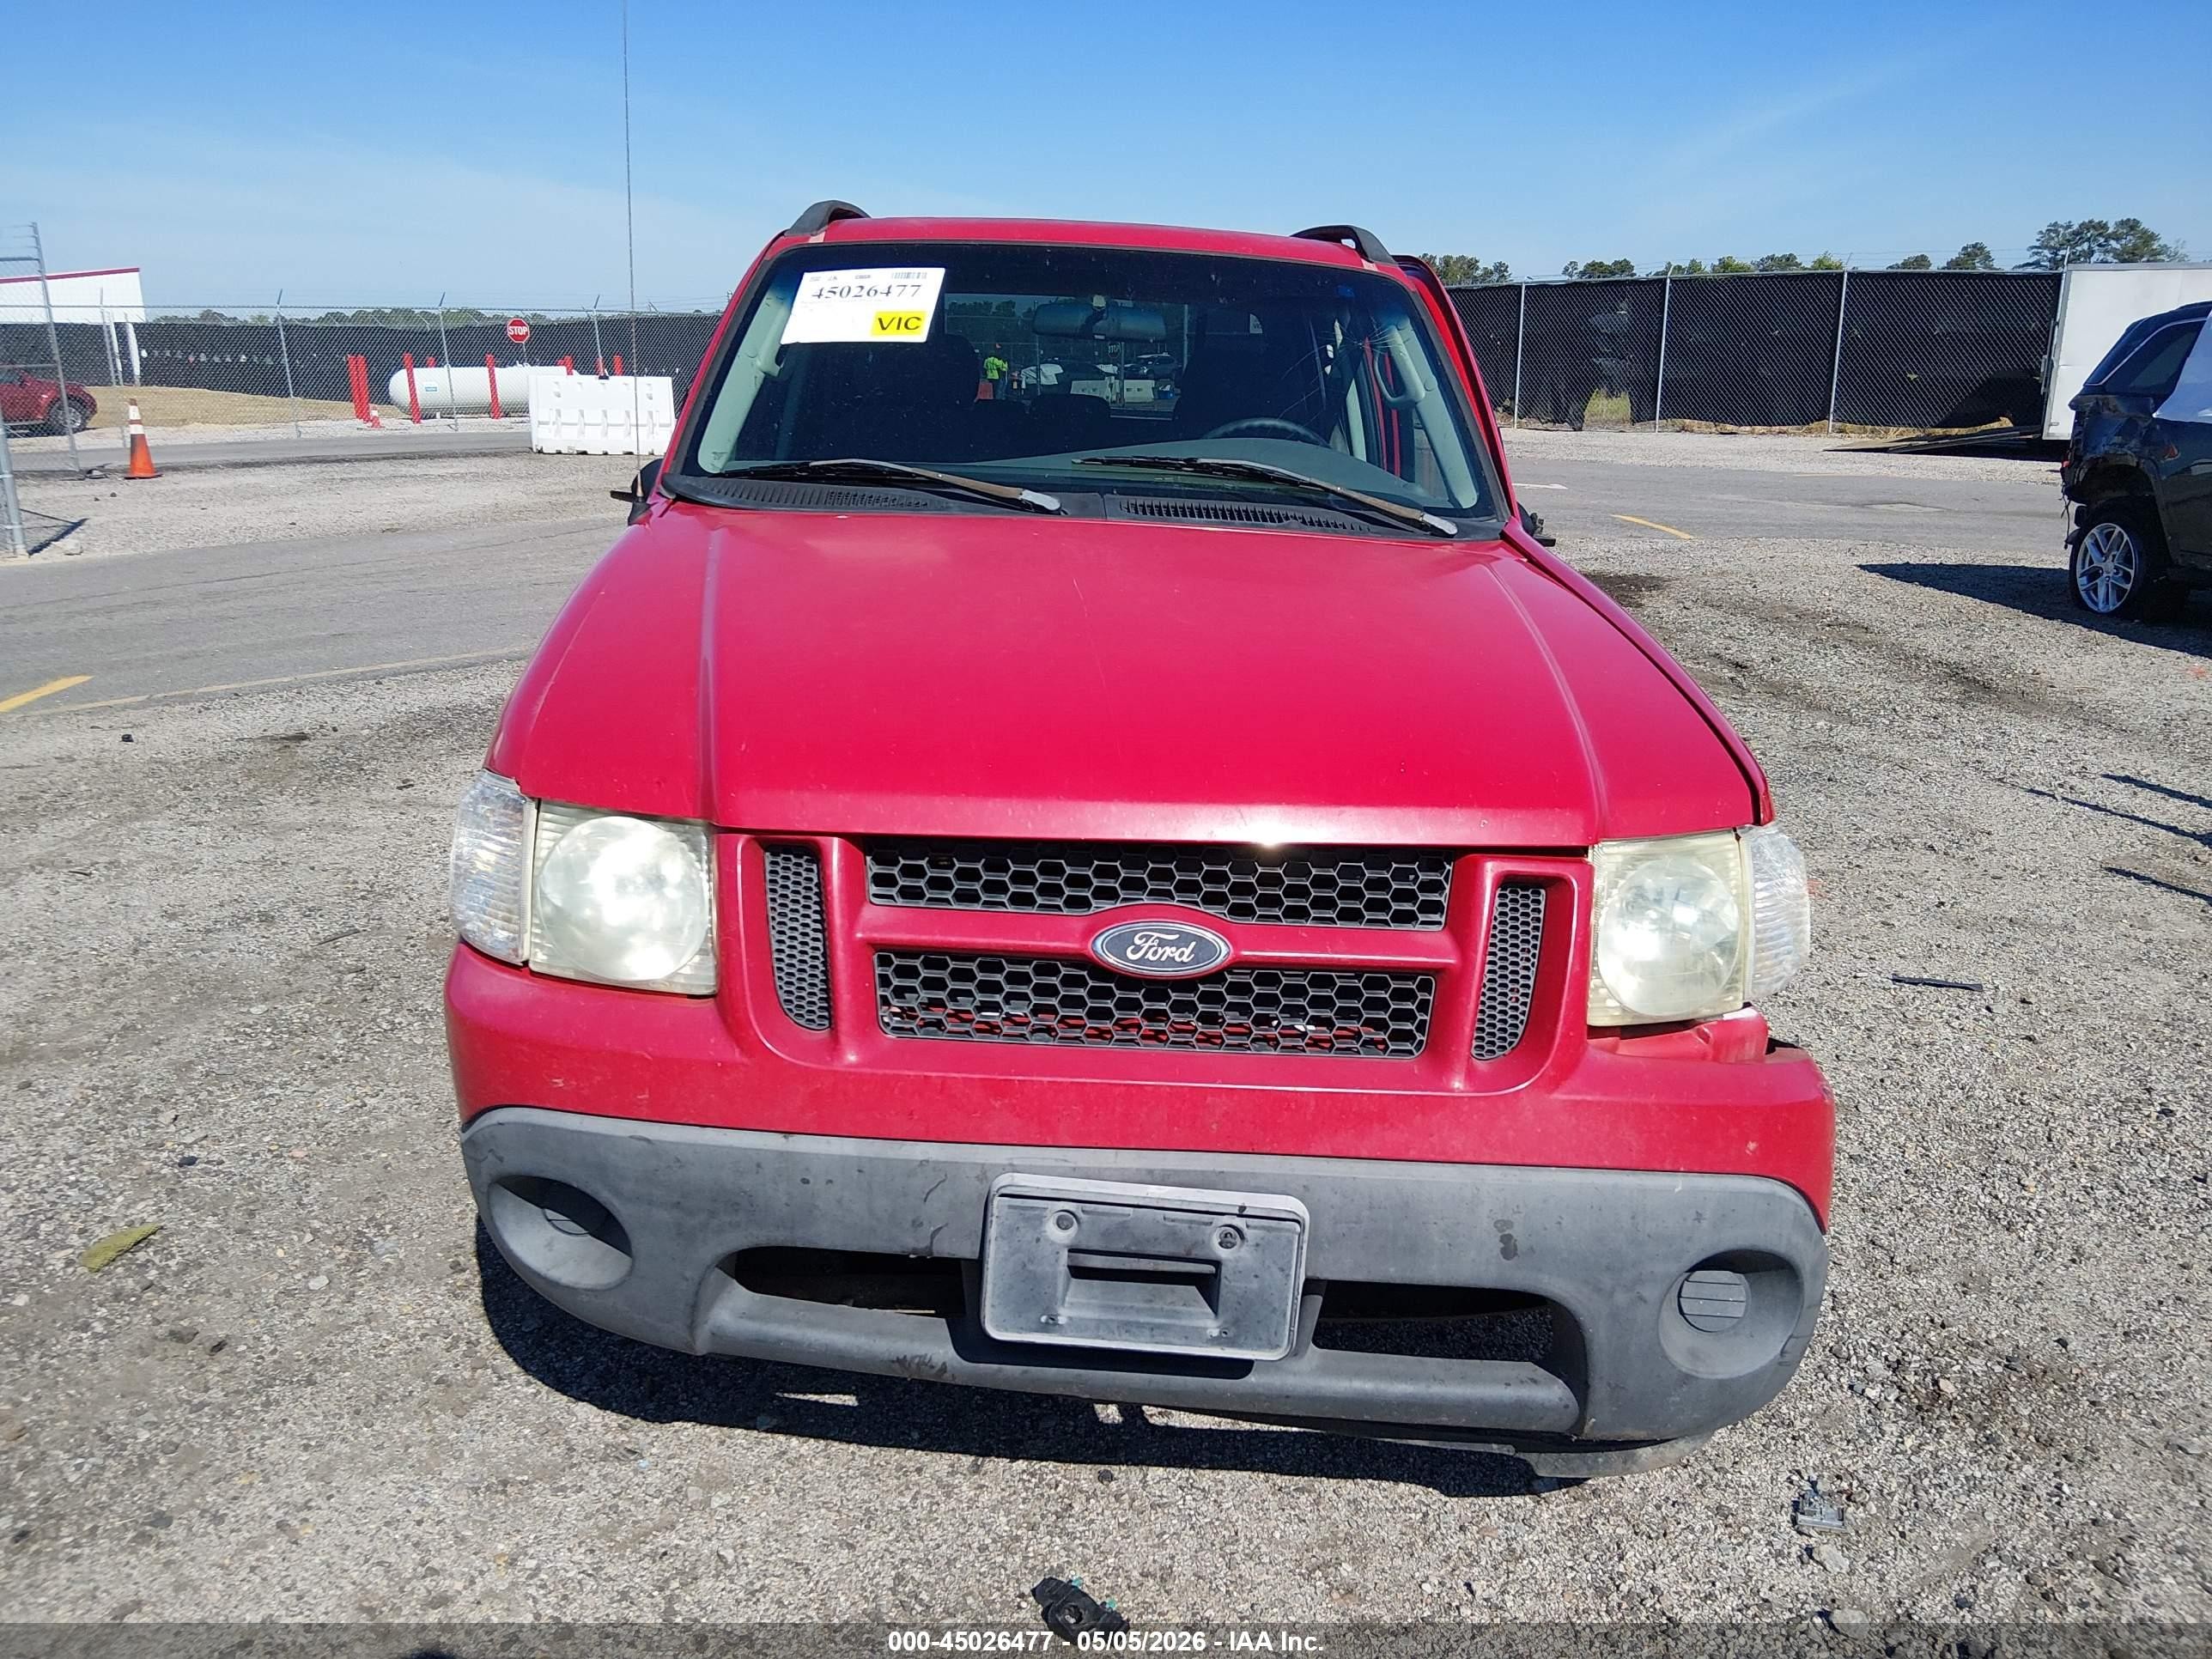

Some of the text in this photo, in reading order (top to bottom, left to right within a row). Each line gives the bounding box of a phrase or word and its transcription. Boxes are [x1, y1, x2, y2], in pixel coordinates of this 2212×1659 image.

[811, 284, 922, 300] 45026477
[508, 325, 528, 336] STOP
[877, 316, 922, 331] VIC
[1126, 931, 1197, 963] Ford
